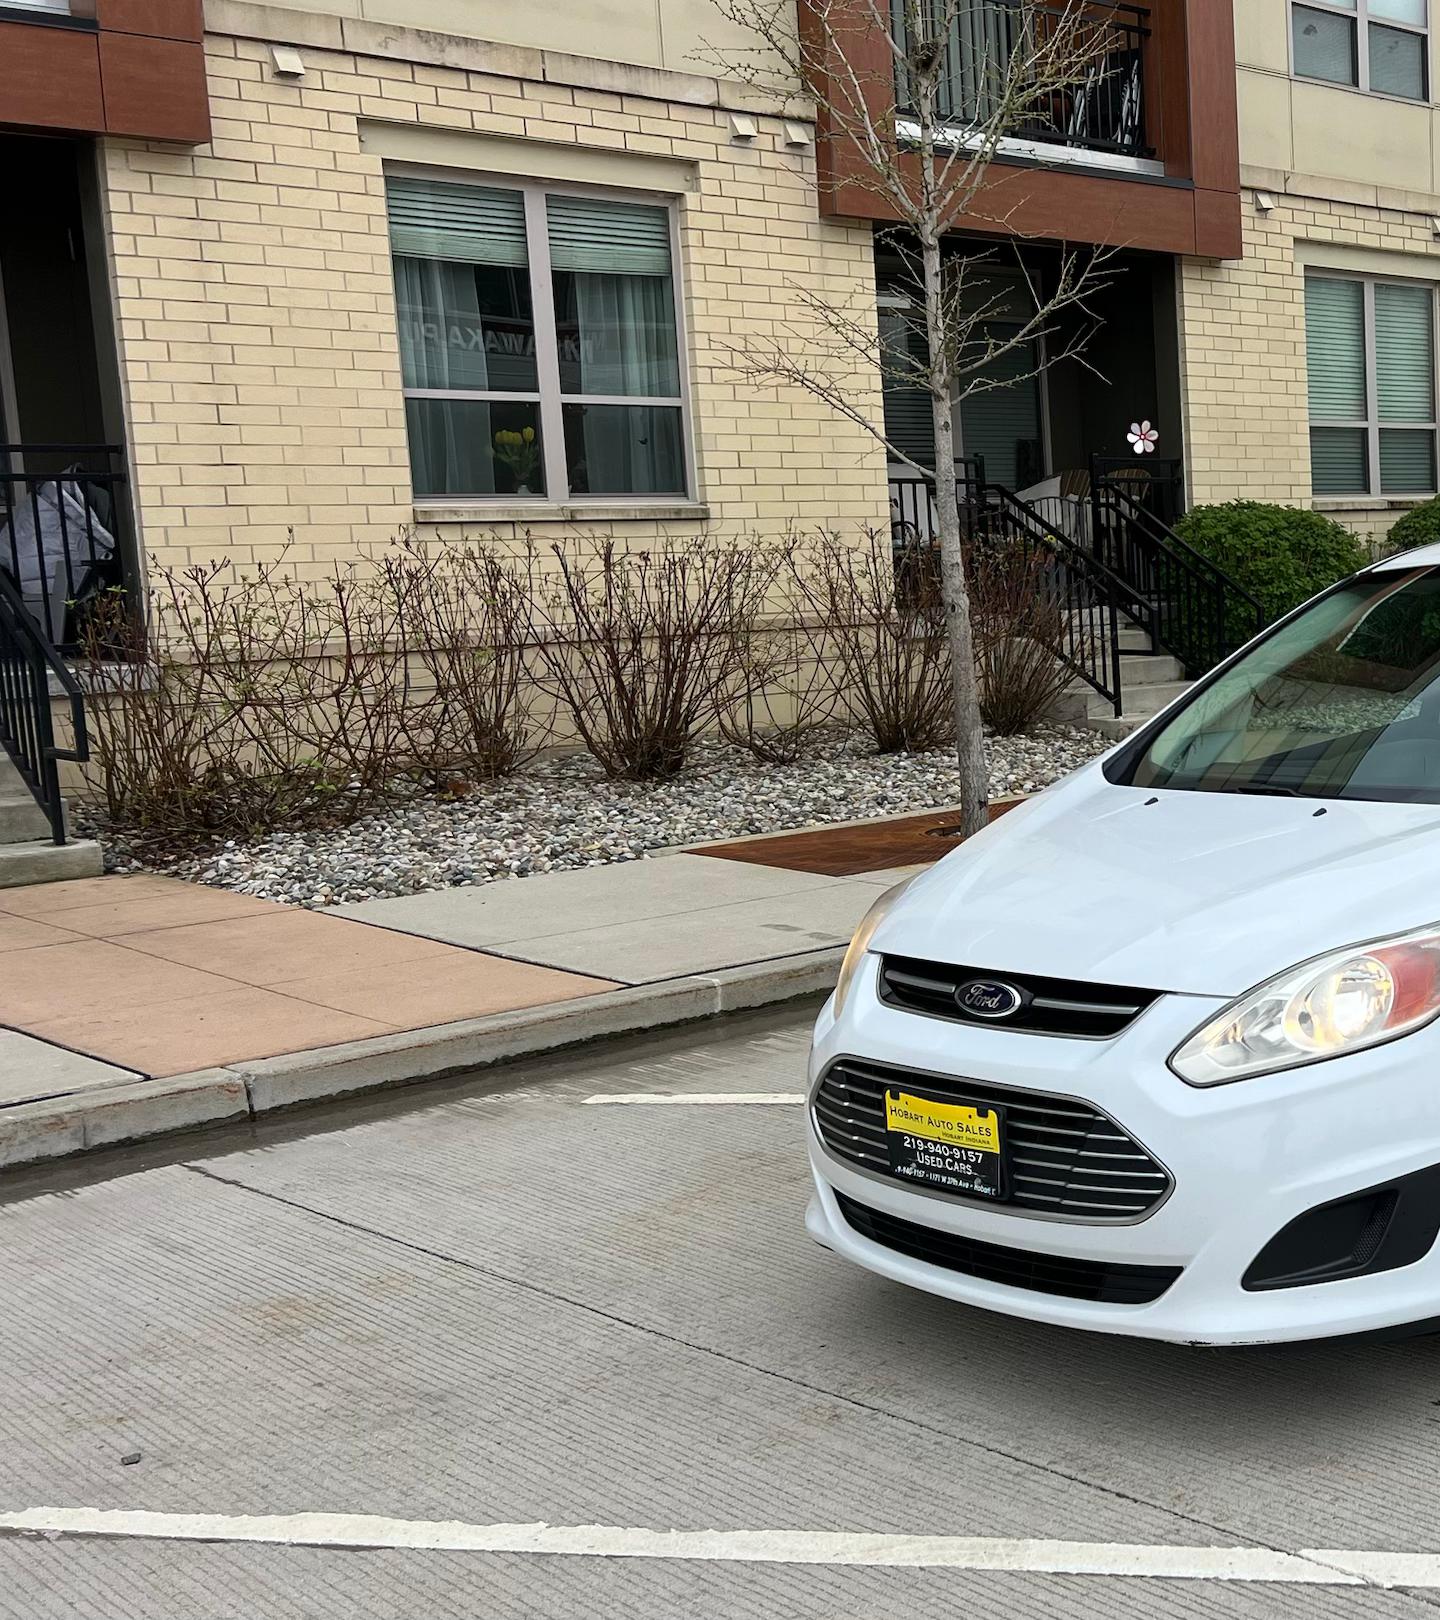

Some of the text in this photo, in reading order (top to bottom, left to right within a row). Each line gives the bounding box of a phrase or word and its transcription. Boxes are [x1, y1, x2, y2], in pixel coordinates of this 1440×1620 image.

[965, 984, 1003, 1008] Ford
[890, 1106, 992, 1137] HOBART AUTO SALES
[903, 1135, 983, 1164] 219-940-9157
[916, 1152, 973, 1175] USED CARS
